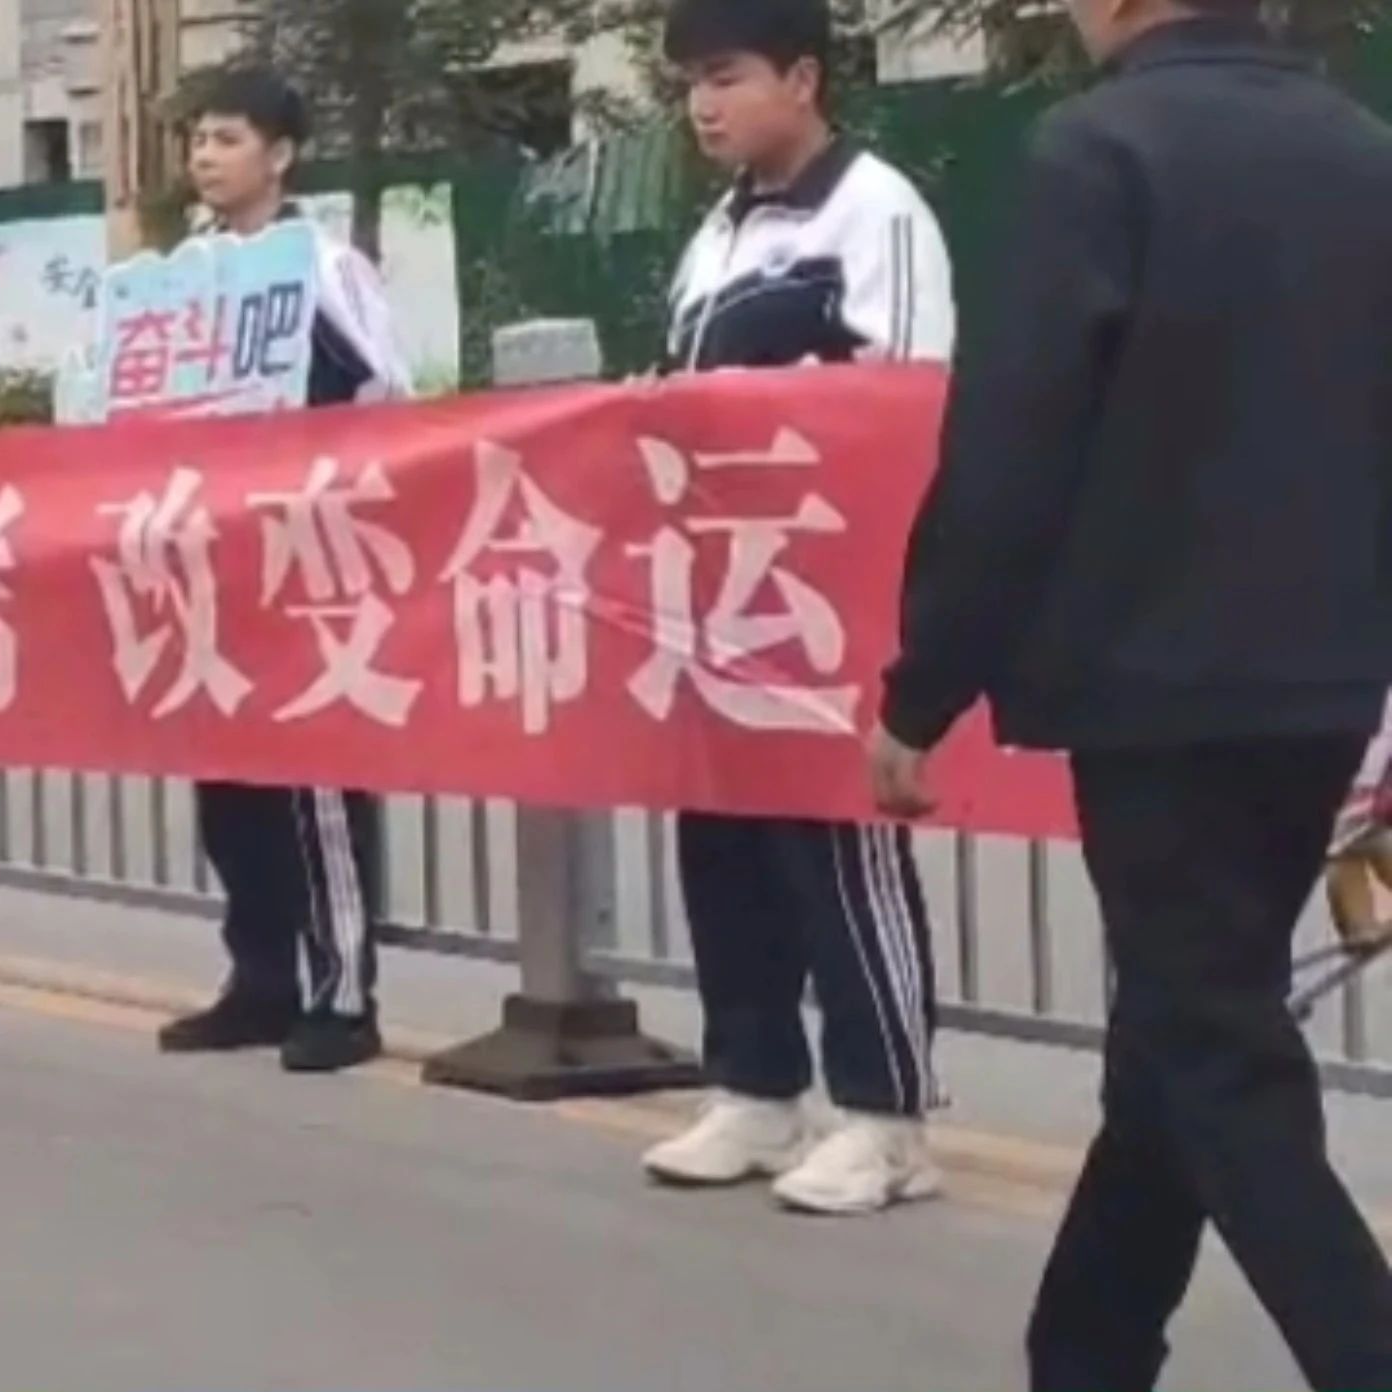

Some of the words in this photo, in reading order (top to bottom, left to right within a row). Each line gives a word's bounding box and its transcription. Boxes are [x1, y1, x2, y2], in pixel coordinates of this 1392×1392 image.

[110, 280, 305, 397] 奋斗吧
[91, 430, 866, 740] 改变命运
